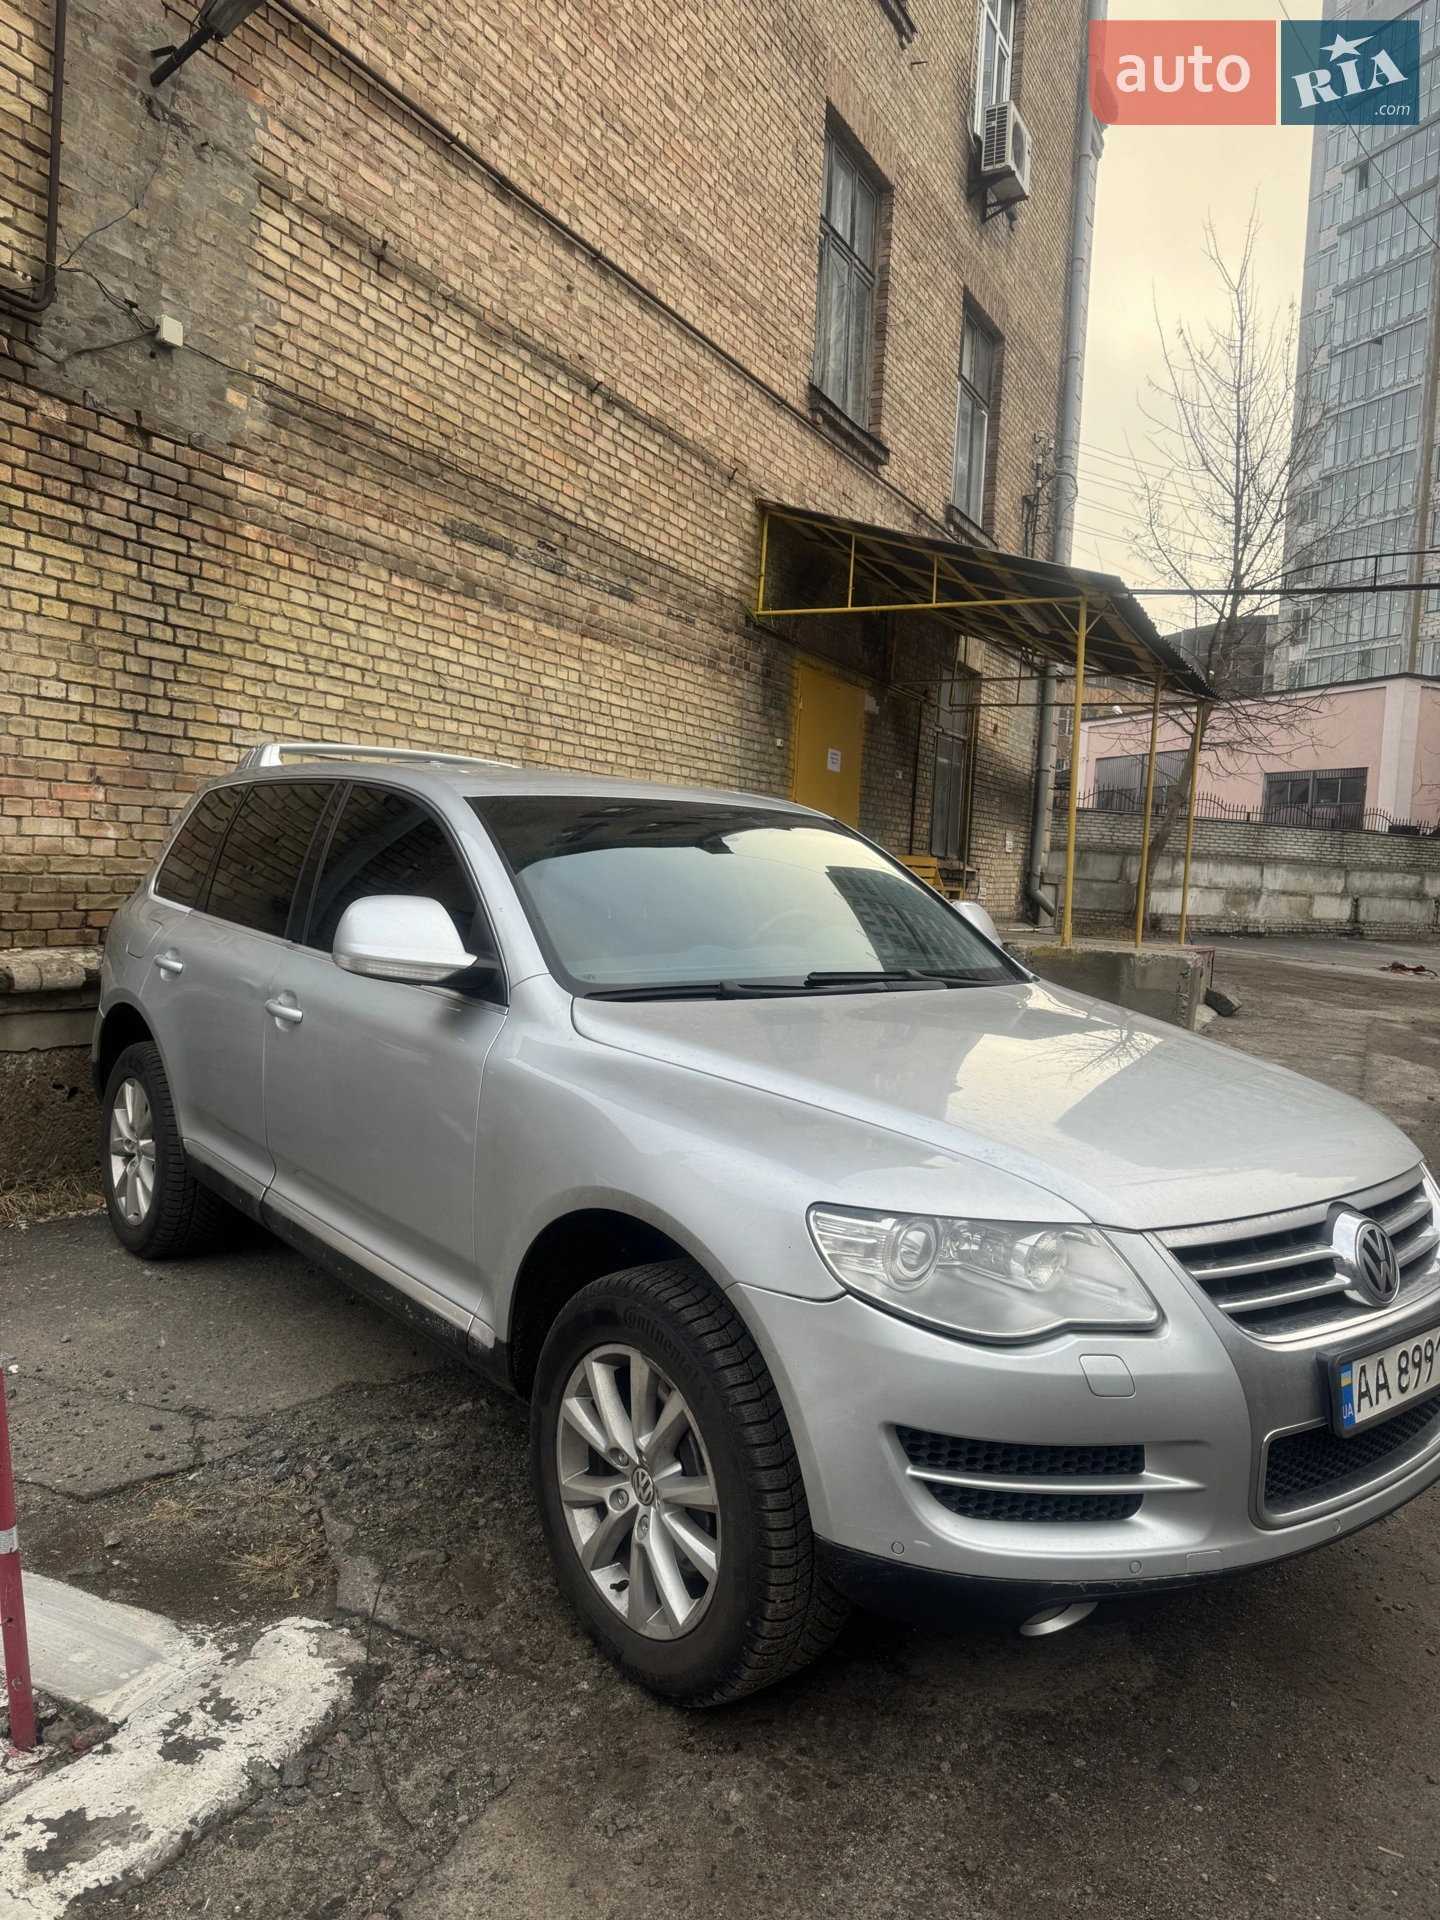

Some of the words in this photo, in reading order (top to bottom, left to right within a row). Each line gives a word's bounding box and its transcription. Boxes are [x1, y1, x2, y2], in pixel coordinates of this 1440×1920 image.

[624, 1306, 698, 1384] Continental
[1342, 1403, 1354, 1419] UA
[1357, 1356, 1392, 1413] AA
